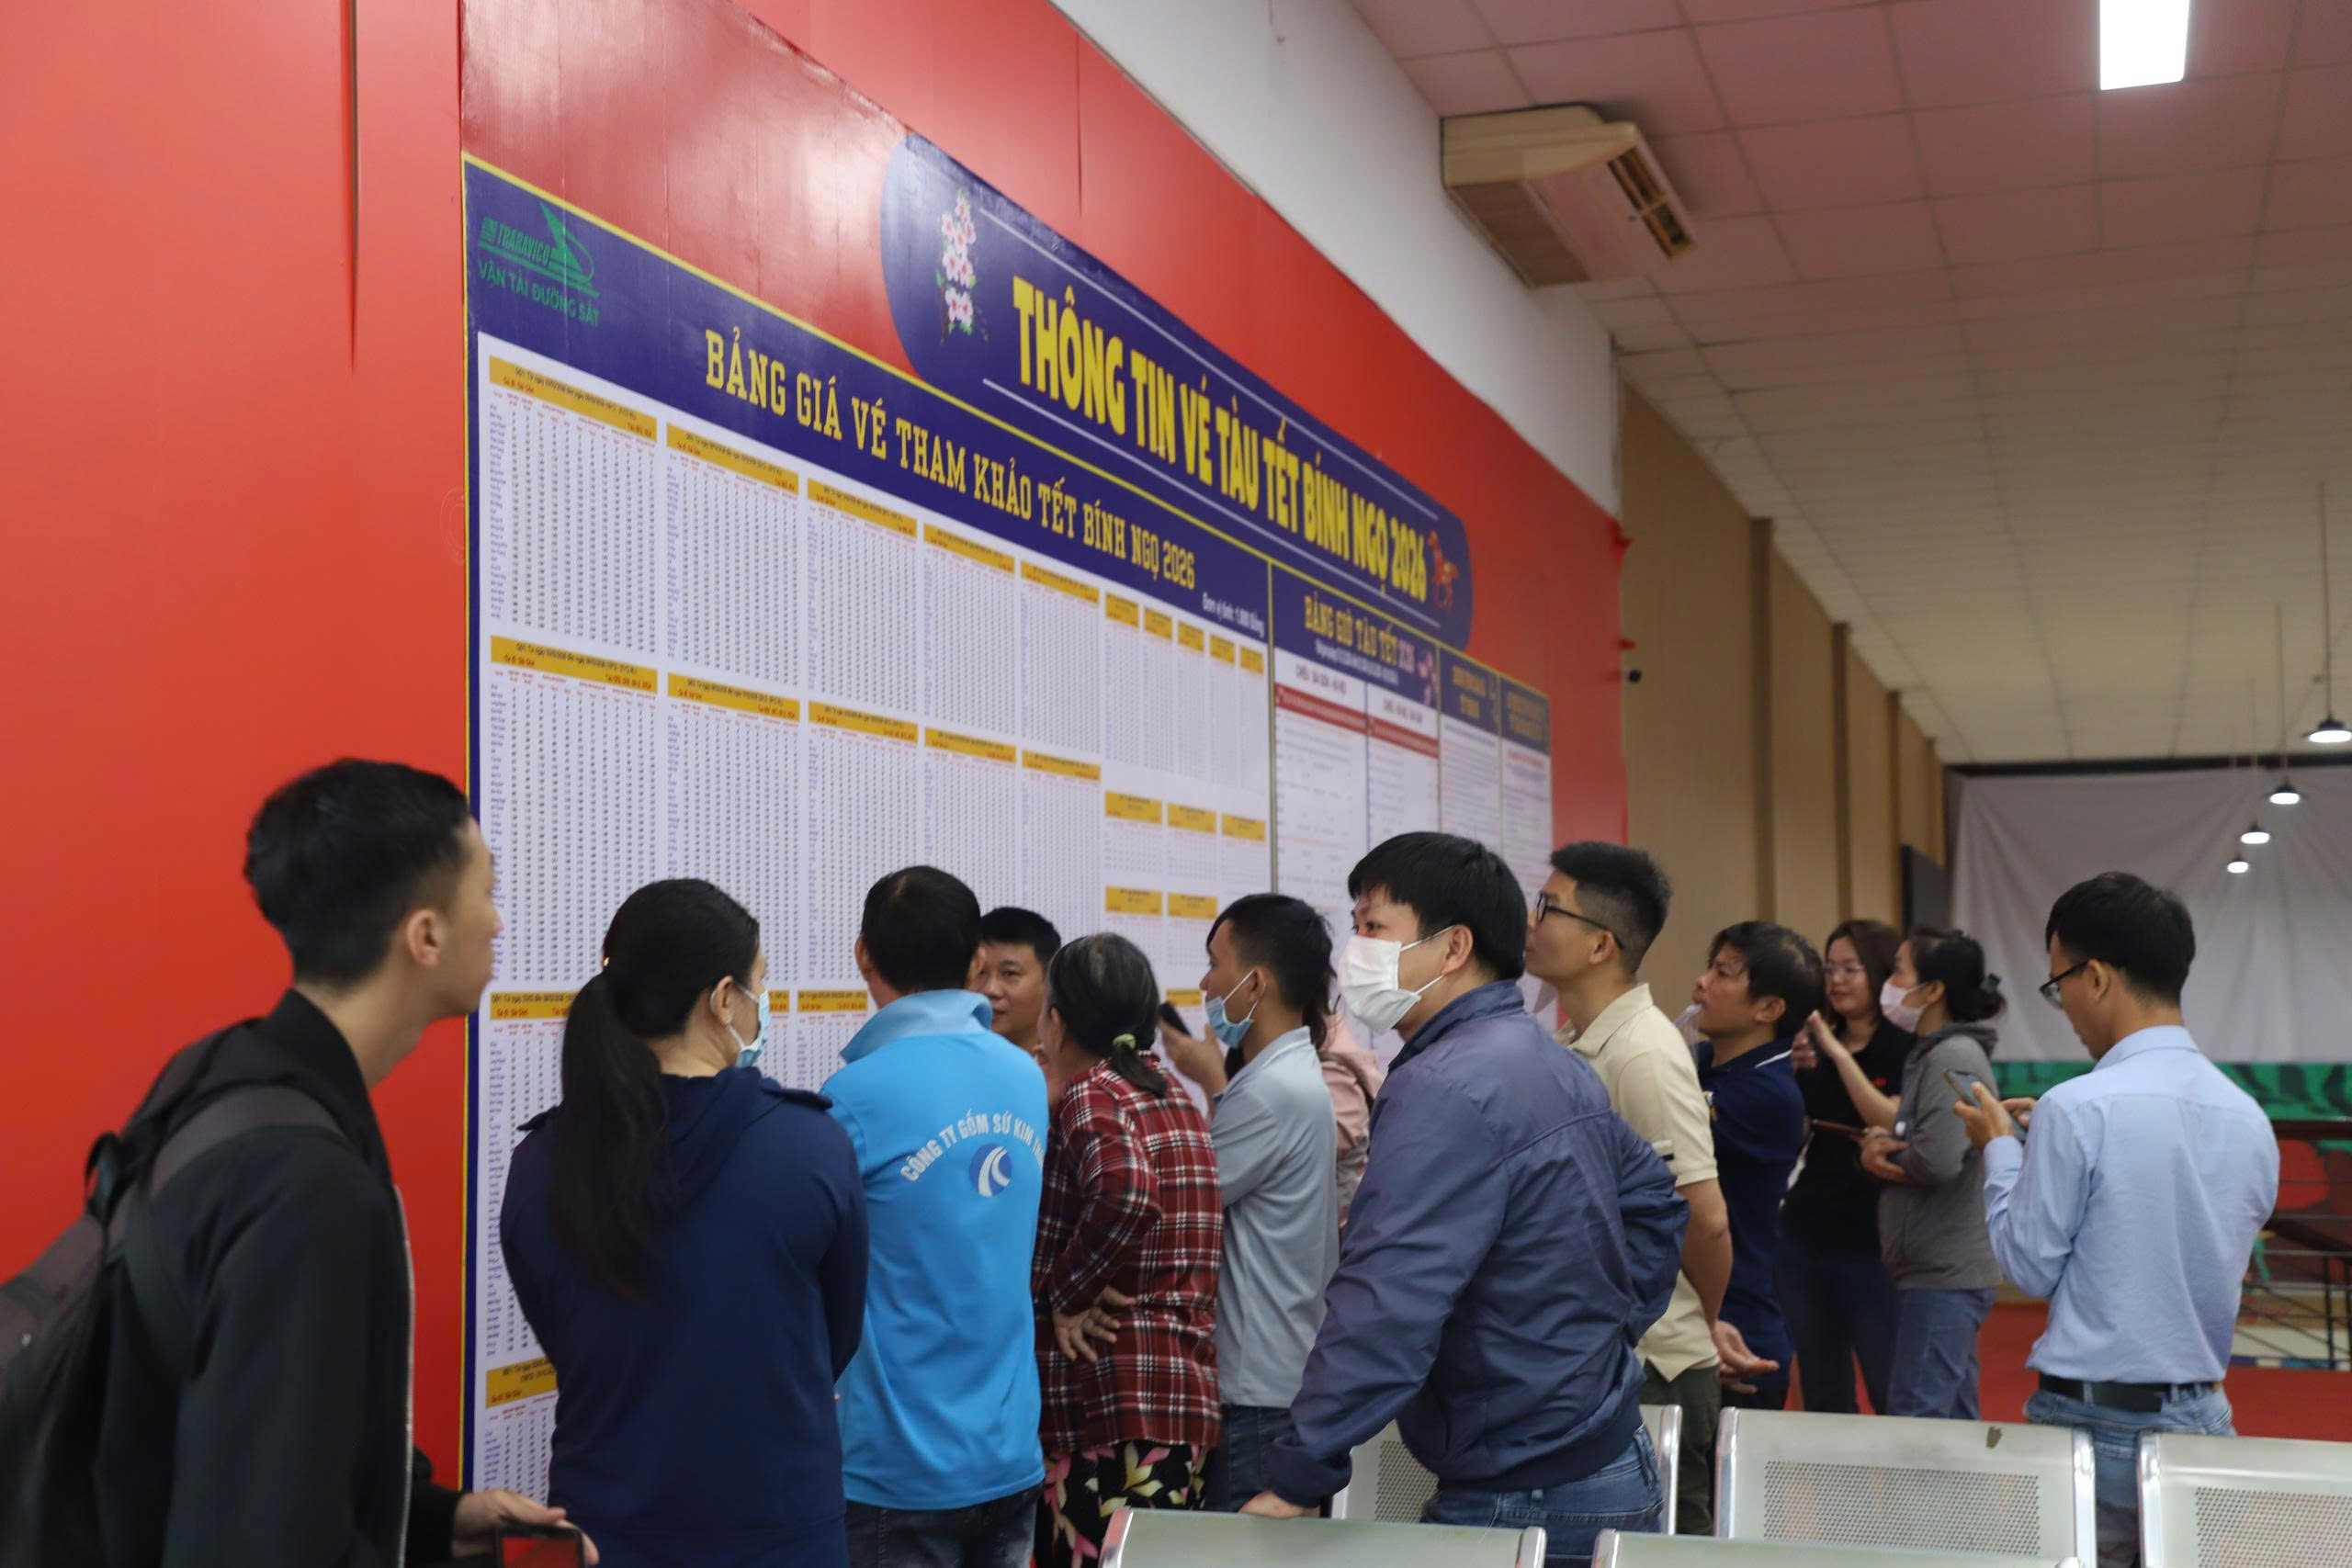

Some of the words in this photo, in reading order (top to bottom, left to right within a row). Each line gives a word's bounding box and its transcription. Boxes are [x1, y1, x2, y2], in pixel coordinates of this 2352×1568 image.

[478, 258, 505, 288] VẬN
[531, 281, 577, 318] ĐƯỜNG
[706, 325, 786, 416] BẢNG
[797, 375, 842, 441] GIÁ
[852, 397, 887, 460] VÉ
[896, 417, 967, 494] THAM
[973, 457, 1032, 521] KHẢO
[1038, 476, 1077, 540] TẾT
[1083, 499, 1125, 561] BÍNH
[1131, 525, 1160, 581] NGỌ
[1162, 540, 1195, 590] 2026
[1012, 275, 1125, 436] THÔNG
[1131, 349, 1176, 466] TIN
[1180, 373, 1213, 486] VÉ
[1216, 395, 1259, 512] TÀU
[1262, 414, 1299, 534] TẾT
[1302, 451, 1351, 561] BÍNH
[1352, 492, 1388, 597] NGỌ
[1390, 516, 1427, 604] 2026
[1305, 591, 1334, 639] BẢNG
[1355, 616, 1377, 658] TÀU
[1379, 623, 1397, 666] TẾT
[900, 1139, 944, 1182] CÔNG
[938, 1123, 960, 1148] TY
[957, 1109, 989, 1140] GỐM
[992, 1110, 1012, 1135] SỨ
[1013, 1116, 1035, 1148] KIM
